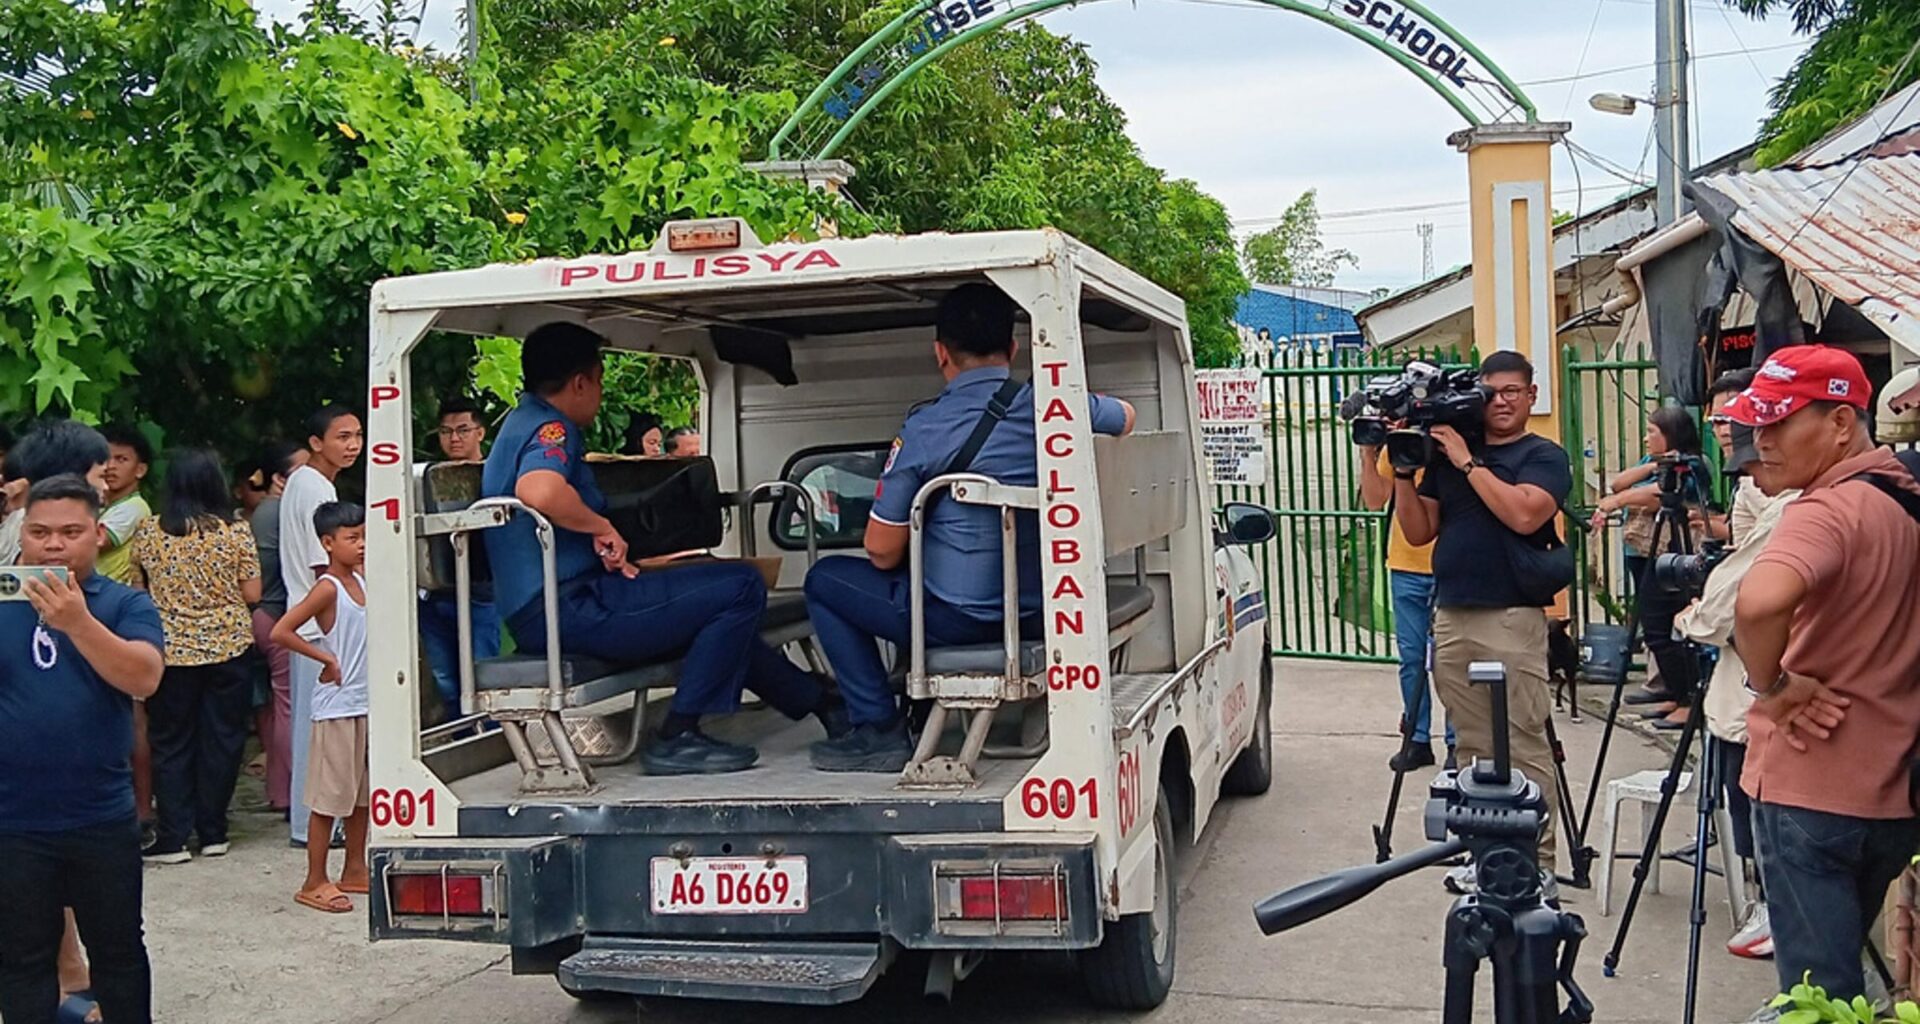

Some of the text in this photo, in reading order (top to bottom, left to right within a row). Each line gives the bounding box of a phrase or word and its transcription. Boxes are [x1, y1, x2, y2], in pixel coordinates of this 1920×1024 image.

[1343, 0, 1467, 88] SCHOOL
[560, 248, 841, 287] PULISYA
[1041, 362, 1085, 636] TACLOBAN
[1047, 664, 1101, 691] CPO
[370, 788, 436, 828] 601
[1021, 777, 1099, 819] 601
[1118, 744, 1141, 839] 601
[670, 871, 789, 905] A6 D669
